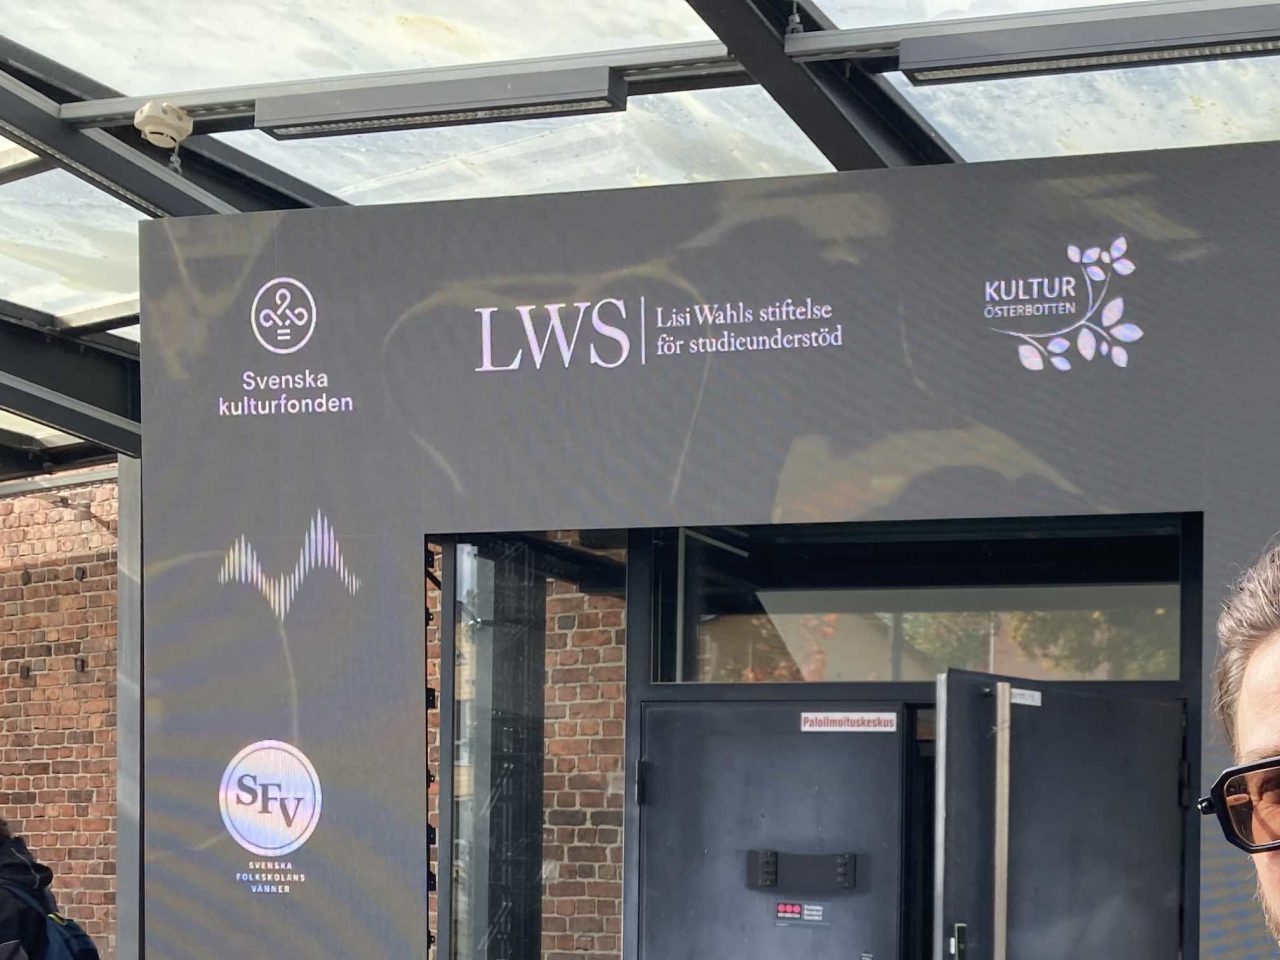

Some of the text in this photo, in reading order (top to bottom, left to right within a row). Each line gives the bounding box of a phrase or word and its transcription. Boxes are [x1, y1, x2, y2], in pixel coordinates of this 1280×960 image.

[984, 276, 1076, 301] KULTUR
[656, 297, 833, 328] Lisi Wahls stiftelse
[983, 301, 1076, 318] ÖSTERBOTTEN
[475, 298, 631, 372] LWS
[656, 325, 842, 355] för studieunderstöd
[242, 369, 328, 390] Svenska
[219, 393, 353, 415] kulturfonden
[803, 715, 894, 729] Paloilmoituskeskus
[236, 773, 304, 828] SFV
[248, 861, 292, 869] SVENSKA
[236, 873, 305, 882] FOLKSKOLANS
